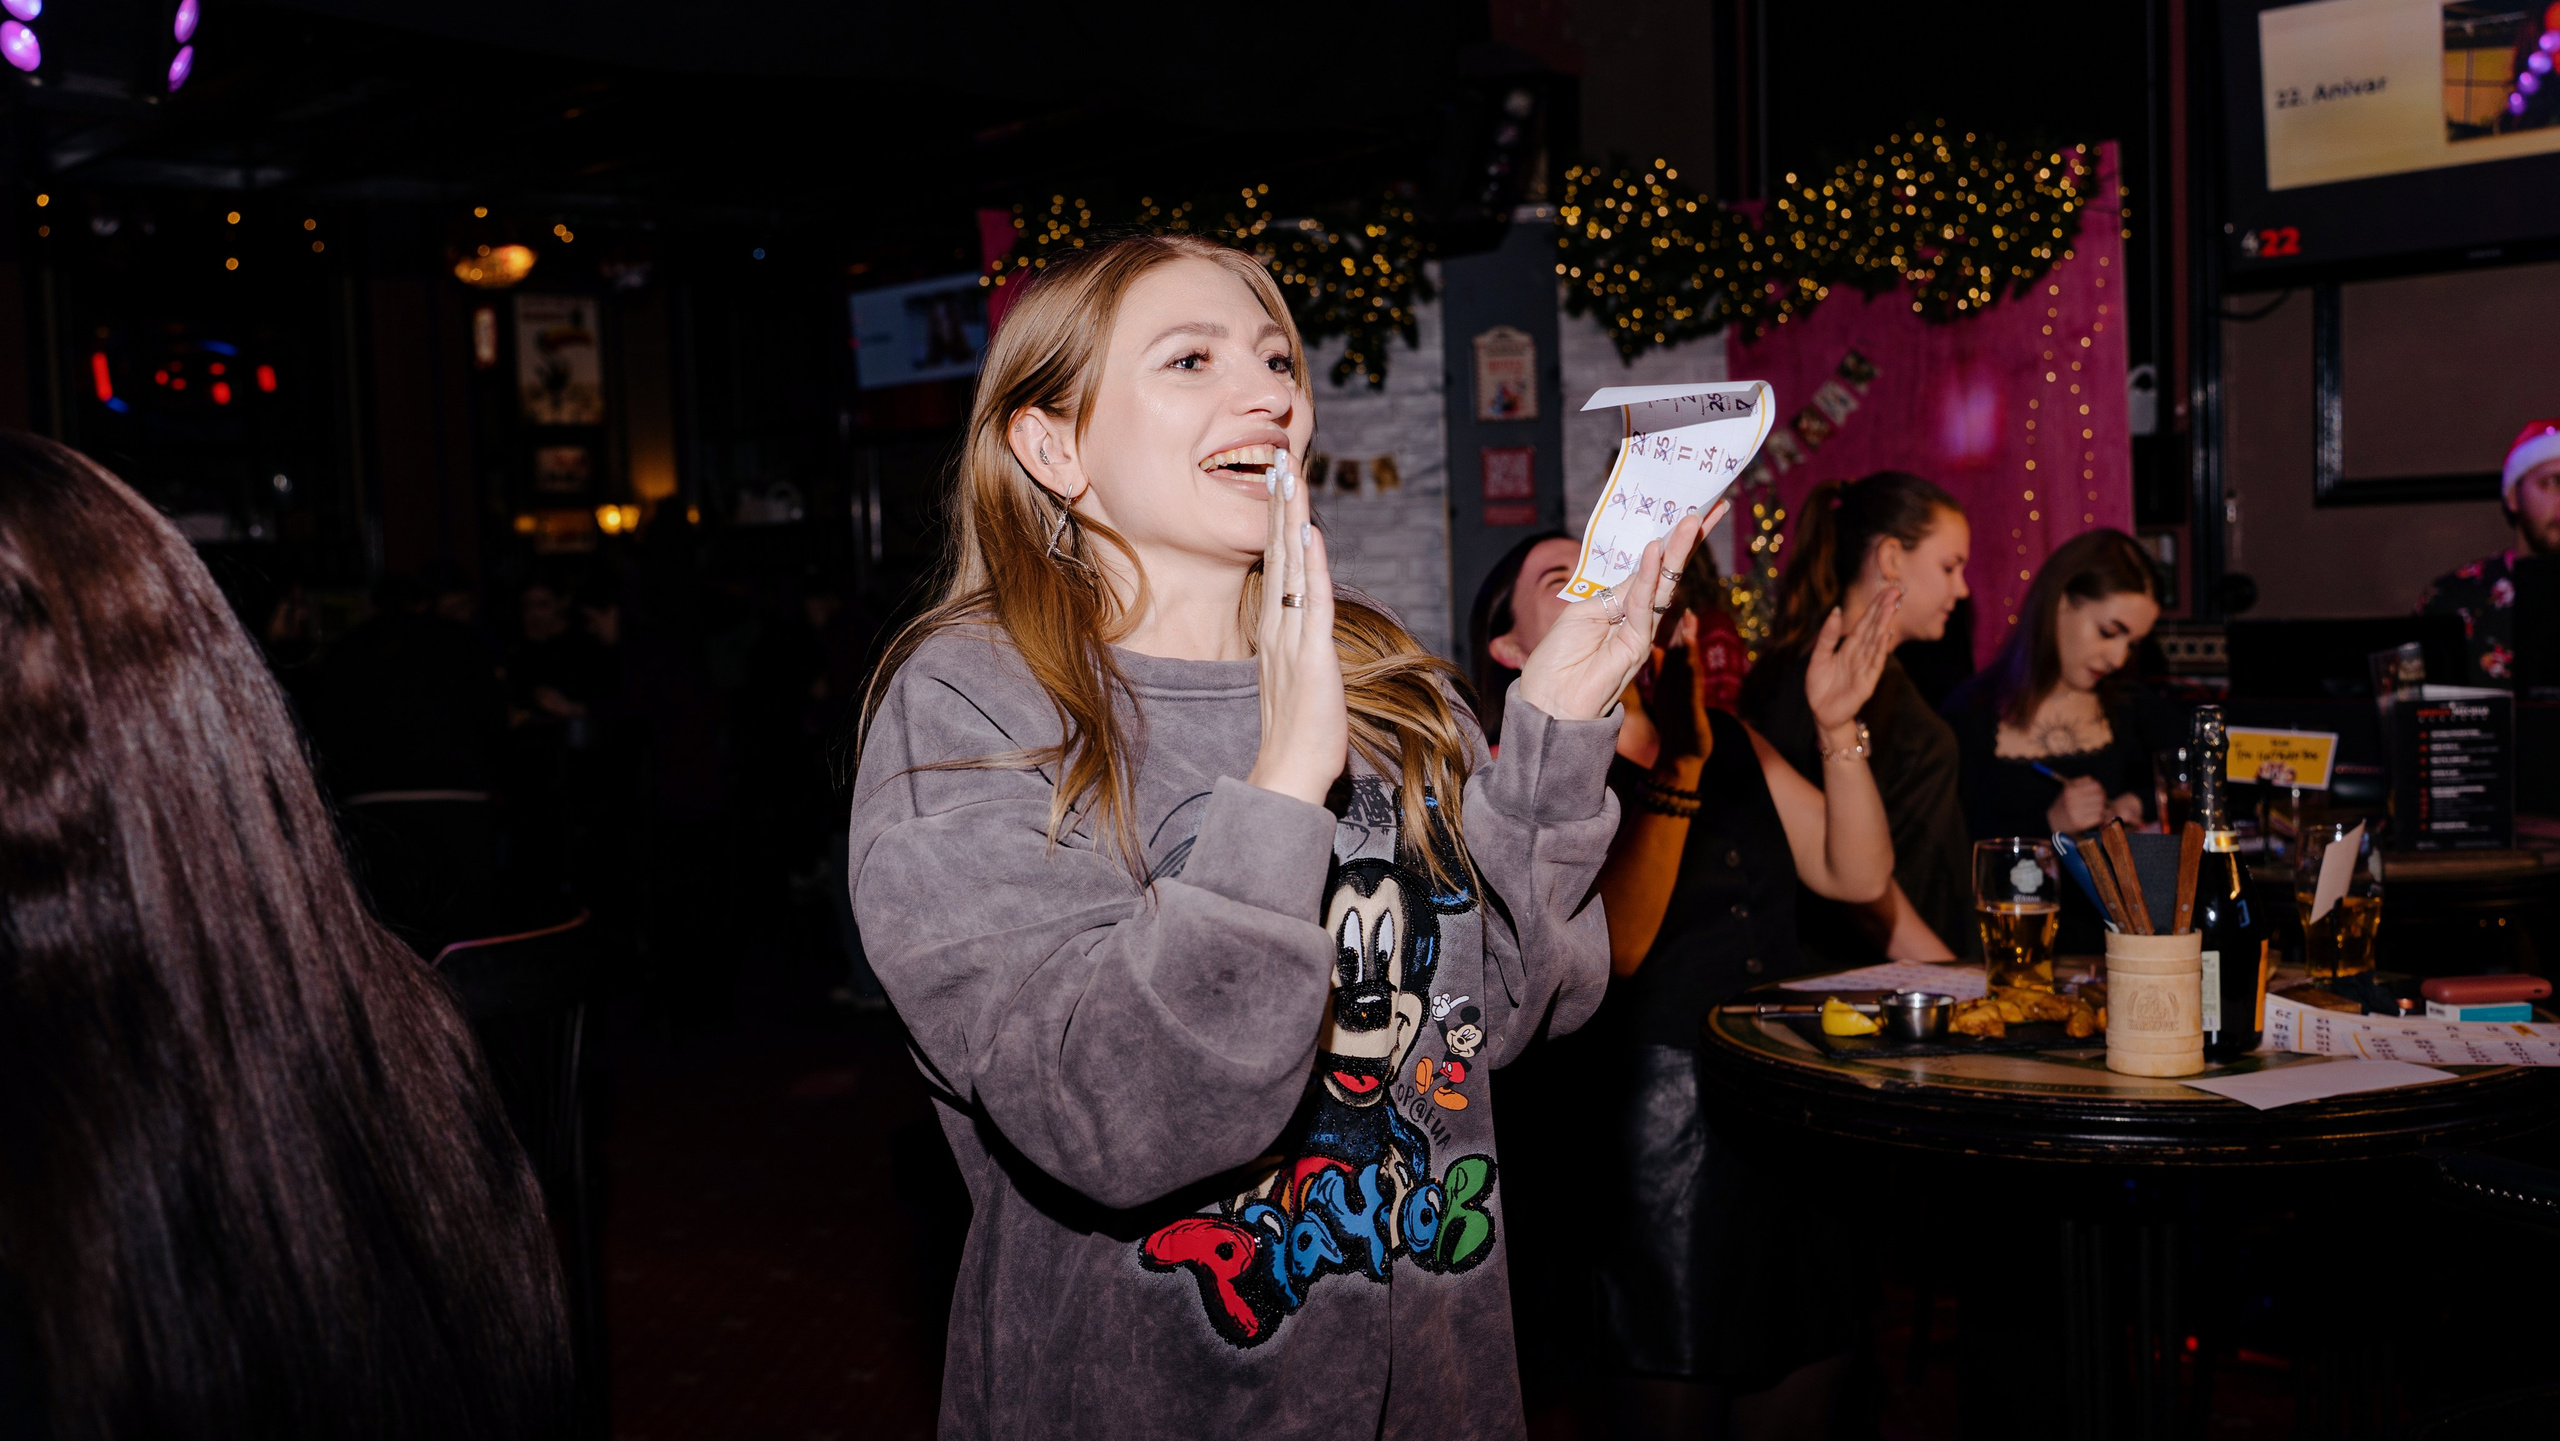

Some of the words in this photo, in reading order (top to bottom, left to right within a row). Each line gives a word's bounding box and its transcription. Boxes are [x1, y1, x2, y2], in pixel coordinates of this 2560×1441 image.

[1653, 435, 1671, 461] 35
[1676, 445, 1693, 461] 11
[1699, 446, 1718, 473] 34
